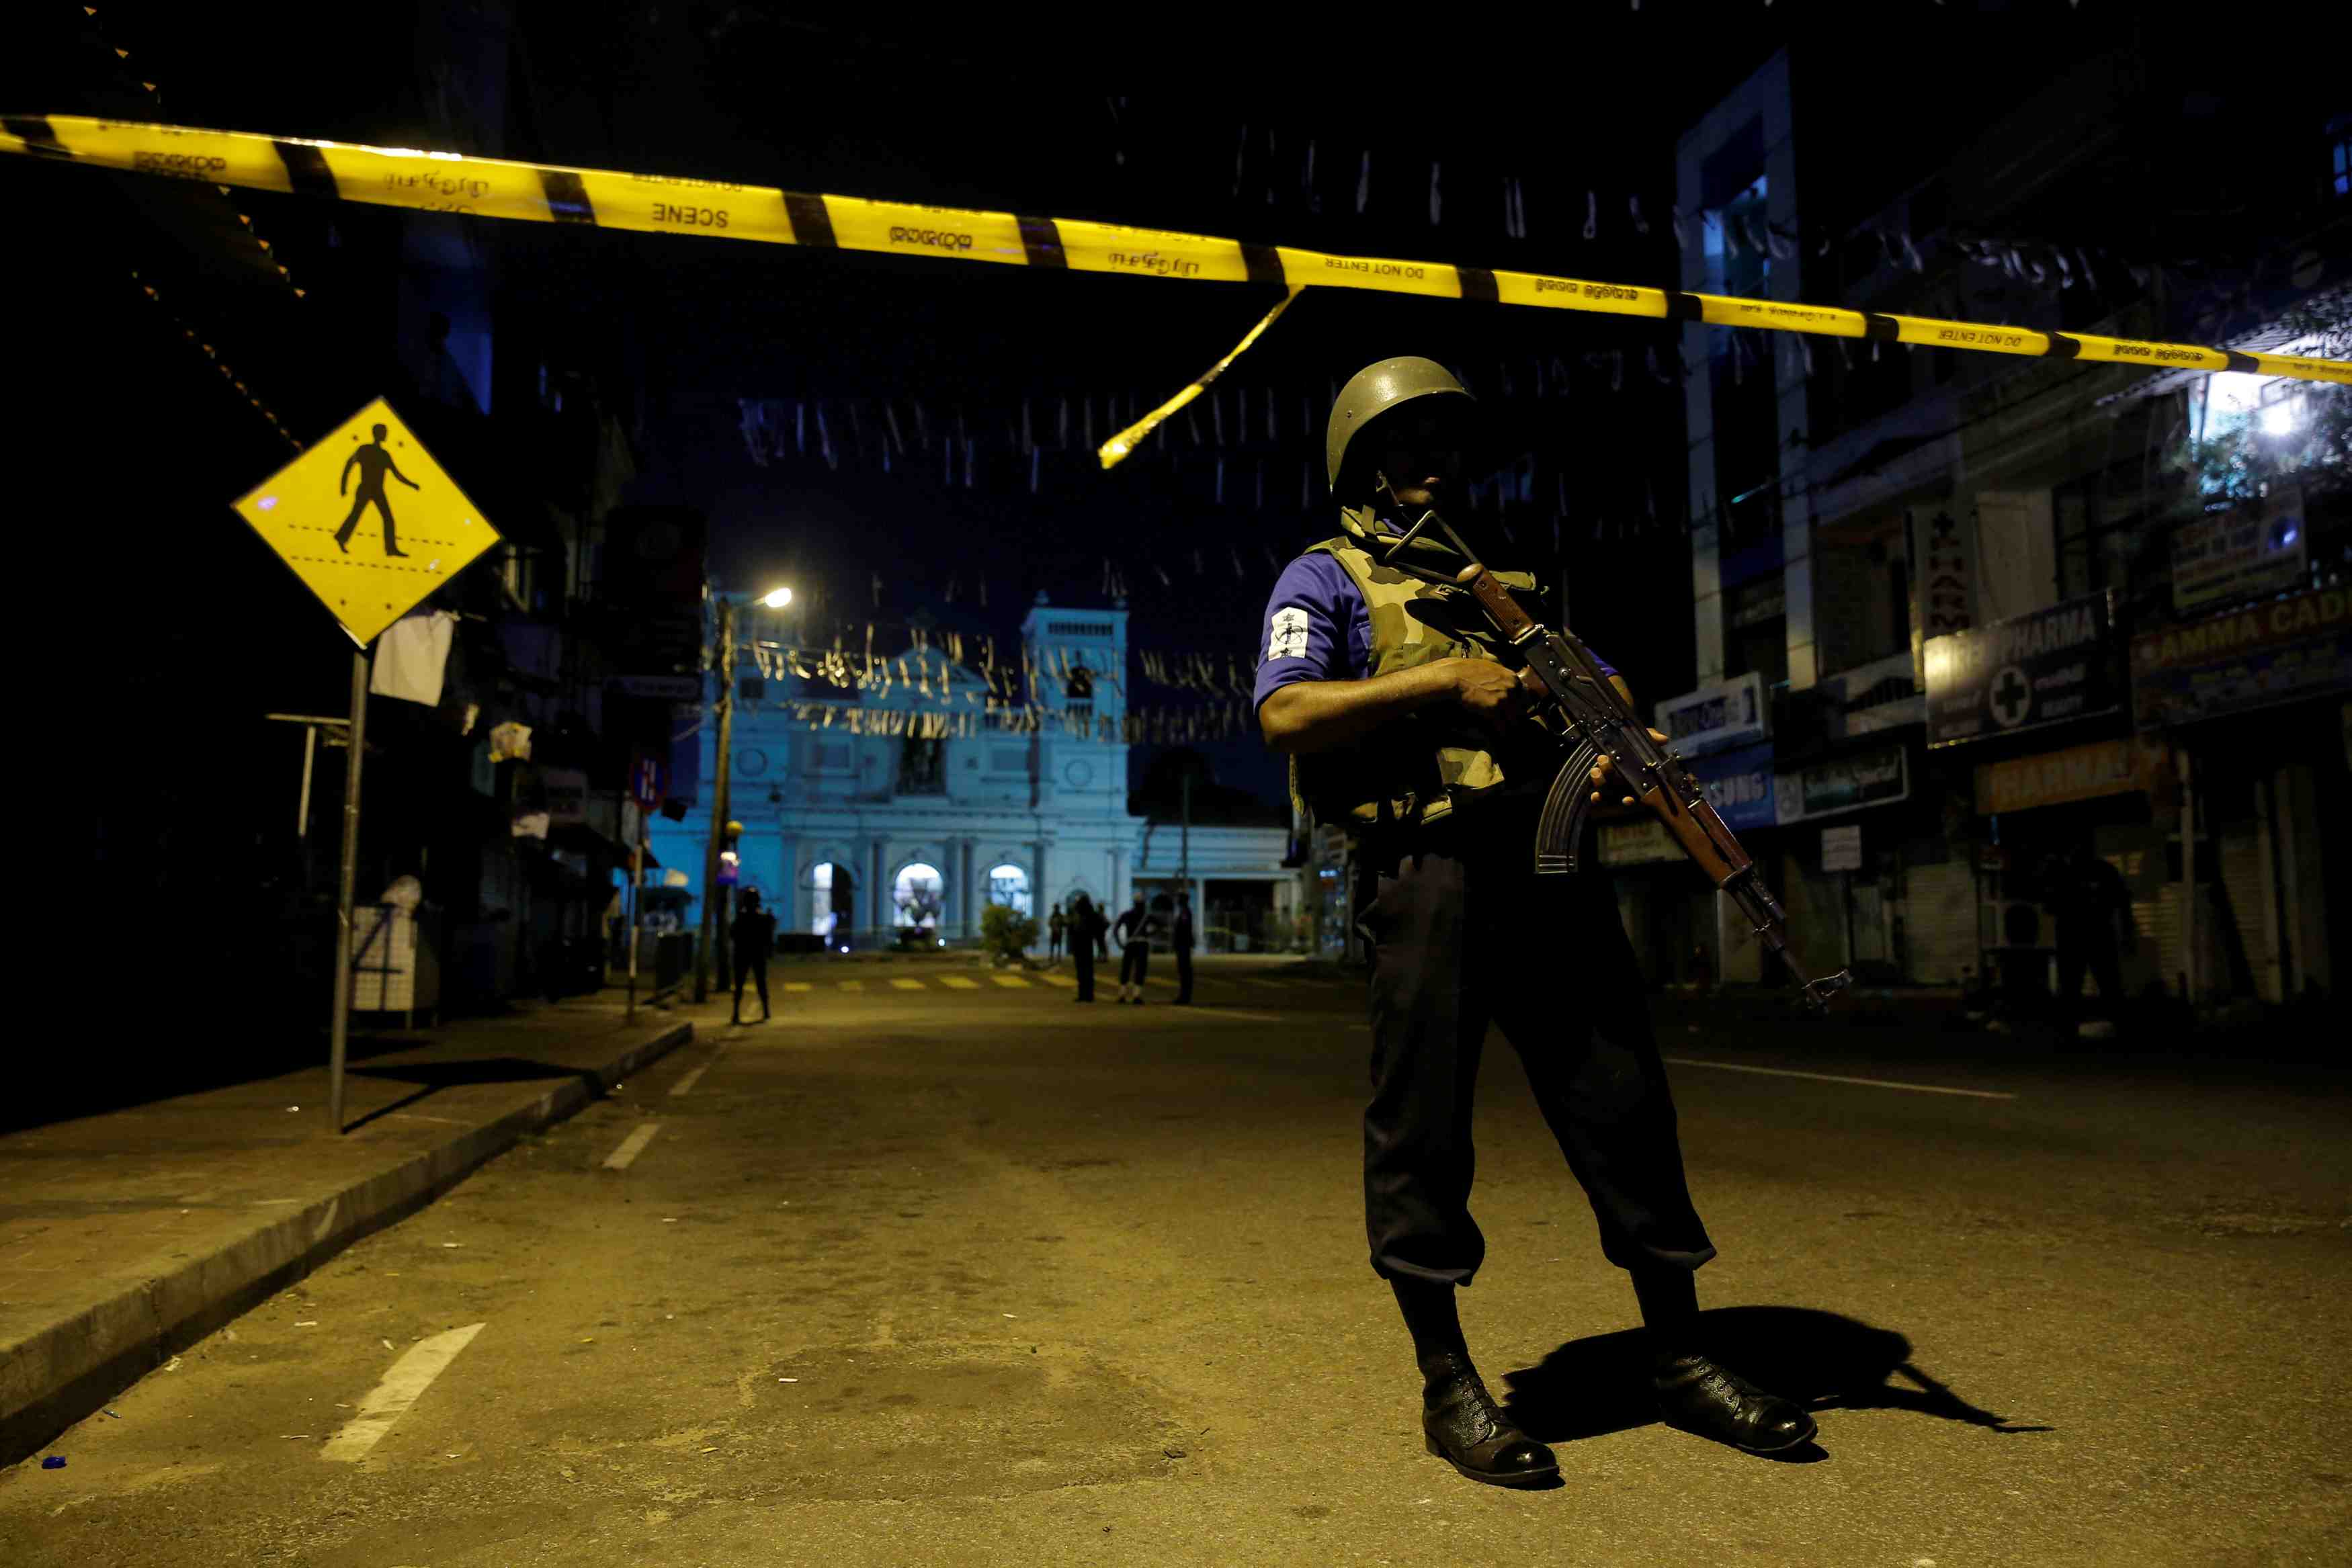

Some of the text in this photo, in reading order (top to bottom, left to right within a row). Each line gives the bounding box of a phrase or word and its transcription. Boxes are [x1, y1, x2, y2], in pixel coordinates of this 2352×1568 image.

[653, 204, 729, 229] SCENE
[1324, 259, 1424, 279] DO NOT ENTER
[1938, 329, 2022, 348] DO NOT ENTER
[2268, 590, 2352, 635] CAD
[1700, 771, 1765, 810] SUNG
